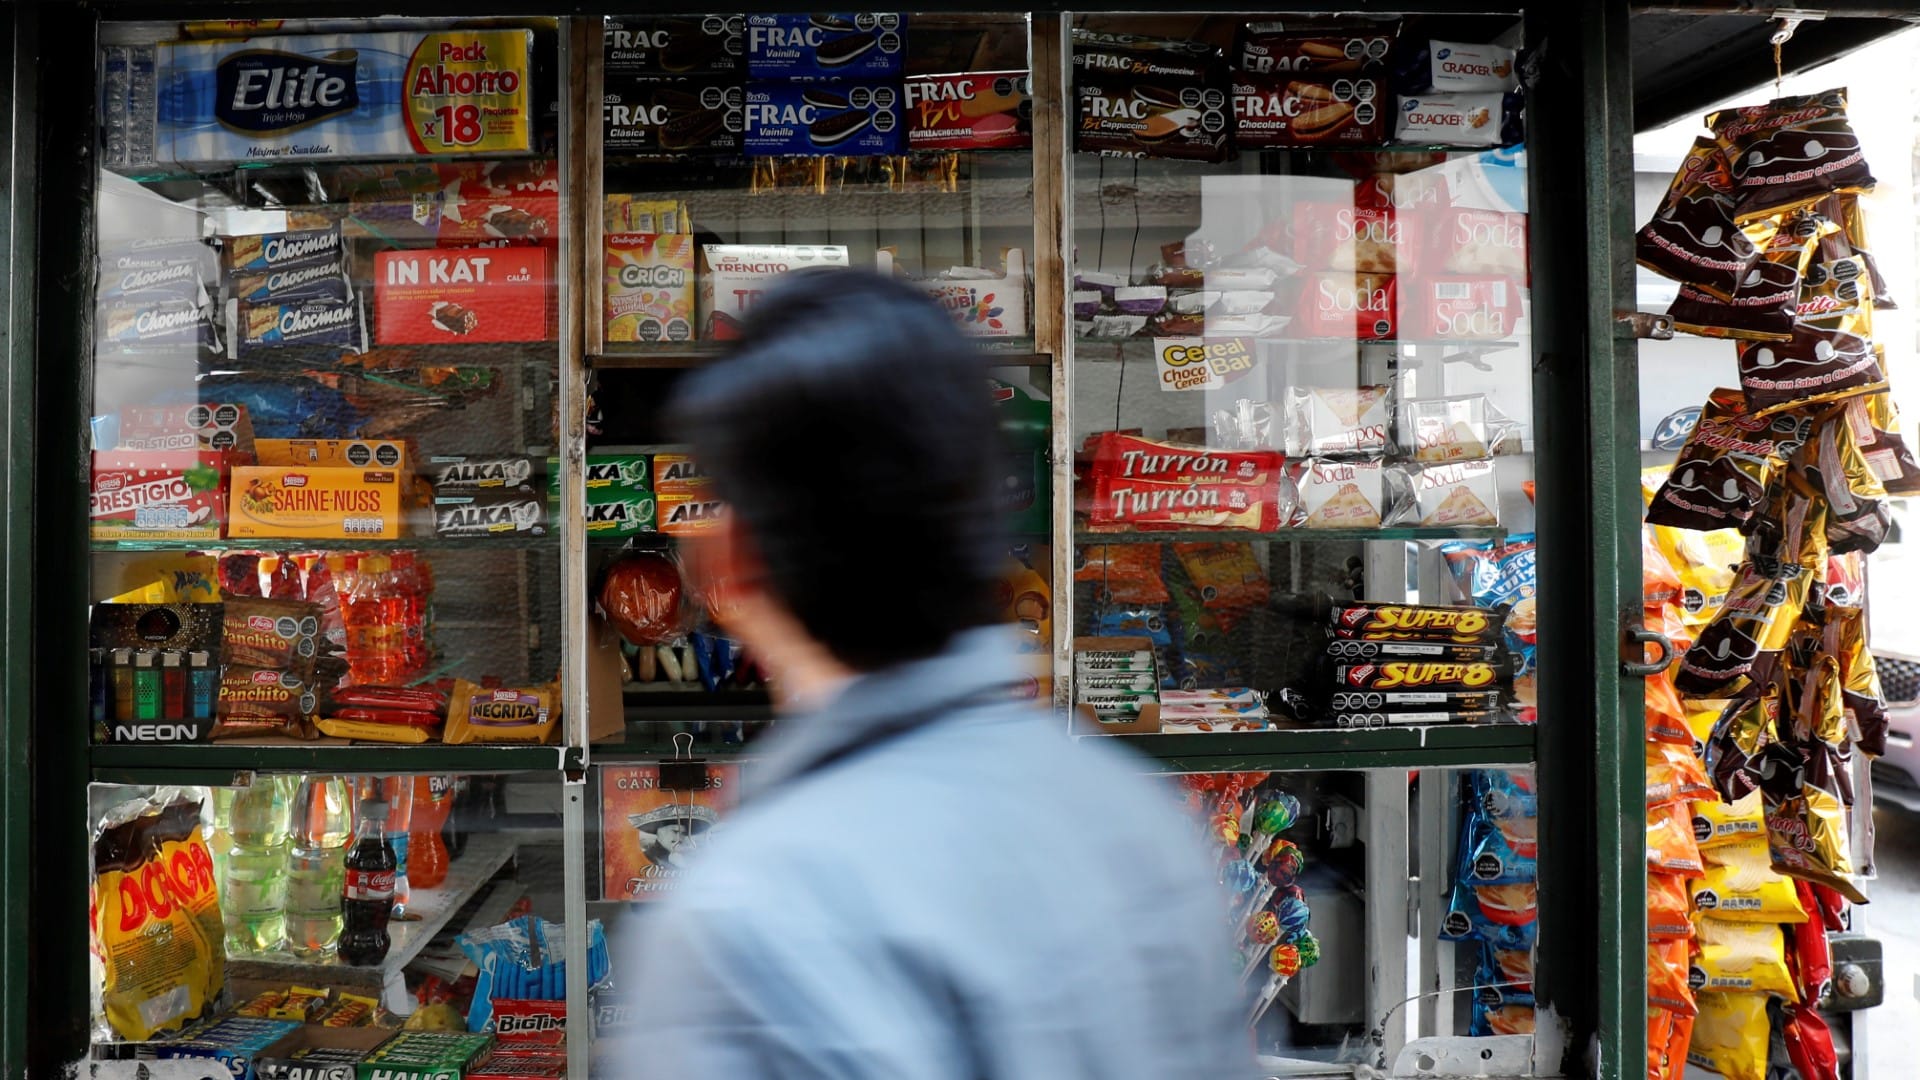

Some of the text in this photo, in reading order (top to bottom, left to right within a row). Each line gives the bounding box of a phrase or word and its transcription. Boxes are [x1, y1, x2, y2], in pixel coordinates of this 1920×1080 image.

[749, 26, 824, 53] FRAC
[439, 41, 487, 62] Pack
[765, 49, 801, 59] Vainilla
[1084, 53, 1132, 71] FRAC
[1149, 65, 1195, 76] Cappuccino
[1241, 53, 1312, 73] FRAC
[1442, 62, 1490, 76] CRACKER
[231, 64, 346, 111] Elite
[413, 65, 519, 97] Ahorro
[903, 80, 976, 110] FRAC
[482, 107, 520, 117] Paquetes
[1080, 95, 1149, 122] FRAC
[1231, 95, 1301, 118] FRAC
[261, 112, 305, 123] Triple Hoja
[743, 104, 817, 132] FRAC
[1100, 119, 1149, 131] Cappuccino
[1238, 119, 1287, 129] Chocolate
[1407, 113, 1465, 126] CRACKER
[758, 127, 794, 137] Vainilla
[1766, 175, 1785, 185] con
[1785, 169, 1815, 183] Sabor
[1375, 177, 1438, 209] Soda
[1335, 208, 1404, 246] Soda
[1455, 212, 1525, 250] Soda
[264, 232, 339, 263] Chocman
[120, 262, 194, 291] Chocman
[267, 261, 341, 292] Chocman
[387, 257, 491, 285] IN KAT
[507, 274, 531, 282] CALAF
[621, 264, 685, 288] CRICRI
[715, 263, 789, 273] TRENCITO
[1319, 279, 1389, 313] Soda
[1796, 295, 1840, 315] nito
[136, 307, 209, 334] Chocman
[279, 306, 353, 335] Chocman
[1435, 302, 1505, 336] Soda
[1163, 338, 1246, 367] Cereal
[1162, 366, 1208, 384] Choco
[1210, 355, 1253, 377] Bar
[1175, 373, 1213, 390] Cereal
[1775, 379, 1794, 390] con
[1794, 375, 1823, 389] Sabor
[1416, 422, 1457, 450] Soda
[1694, 418, 1774, 455] Cubanito
[443, 463, 506, 482] ALKA
[586, 464, 622, 481] KA
[1121, 450, 1229, 478] Turrón
[1311, 462, 1356, 485] Soda
[1423, 462, 1464, 490] Soda
[274, 489, 382, 513] SAHNE-NUSS
[1111, 483, 1220, 520] Turrón
[1229, 489, 1247, 498] dos
[446, 506, 514, 527] ALKA
[223, 617, 247, 630] lfajor
[219, 686, 290, 702] Panchito
[472, 704, 535, 720] NEGRITA
[115, 724, 198, 742] NEON
[429, 776, 450, 793] FAN
[617, 777, 723, 790] CANES
[630, 770, 651, 778] MIS
[639, 863, 683, 879] Vicen
[499, 1013, 567, 1033] BIGTIM
